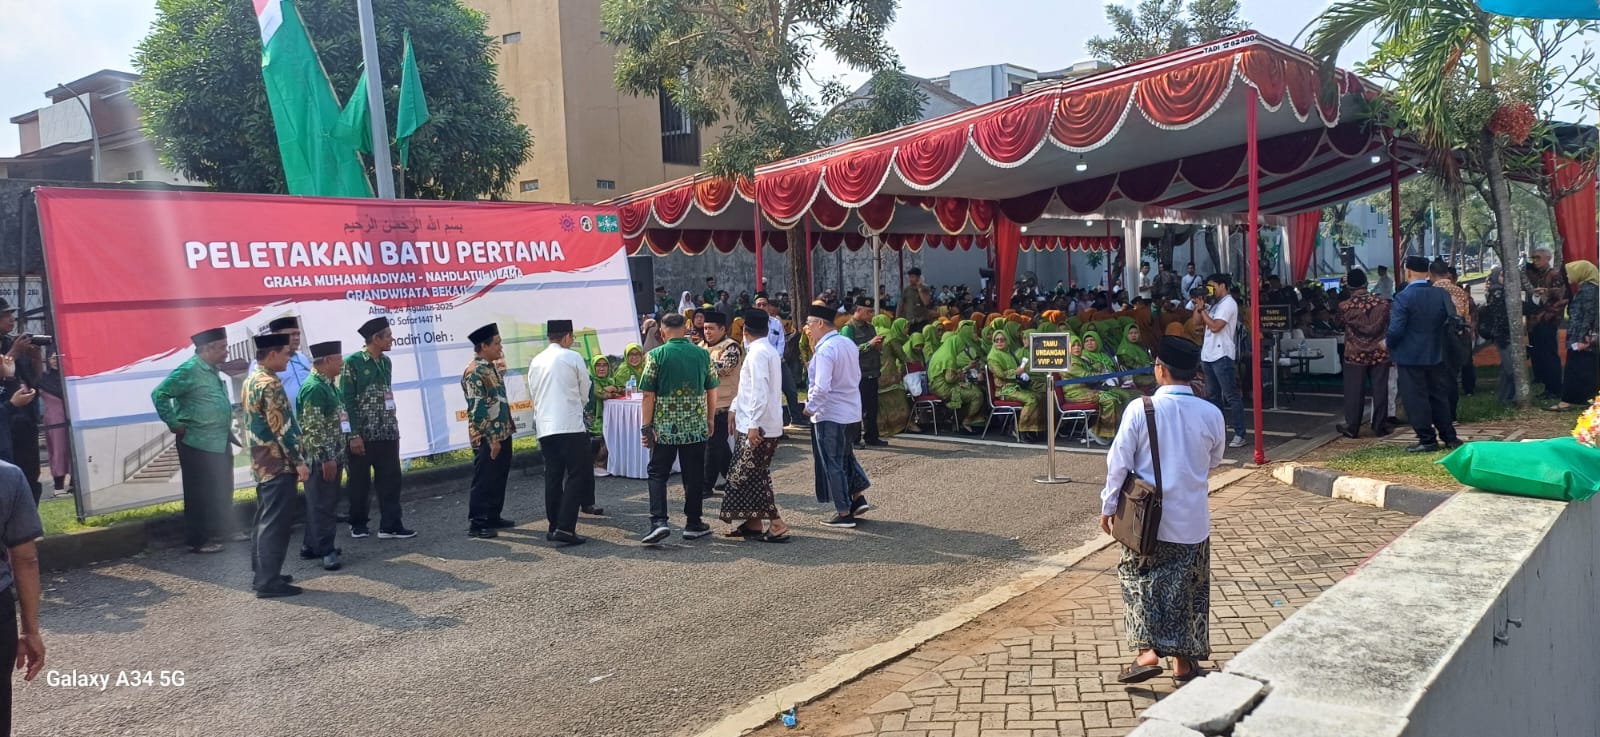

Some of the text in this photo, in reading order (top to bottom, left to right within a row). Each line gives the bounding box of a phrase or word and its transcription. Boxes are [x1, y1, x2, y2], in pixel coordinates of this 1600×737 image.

[1204, 45, 1220, 54] TADI
[184, 240, 565, 270] PELETAKAN BATU PERTAMA
[263, 275, 312, 289] GRAHA
[314, 272, 416, 287] MUHAMMADIYAH
[425, 270, 487, 283] NAHDLATUL
[489, 268, 524, 281] ULAMA
[346, 285, 468, 301] GRANDWISATA BEKASI
[394, 306, 404, 314] 24
[406, 304, 435, 315] Agustus
[436, 303, 454, 311] 2025
[435, 314, 442, 322] H
[424, 331, 447, 344] Oleh
